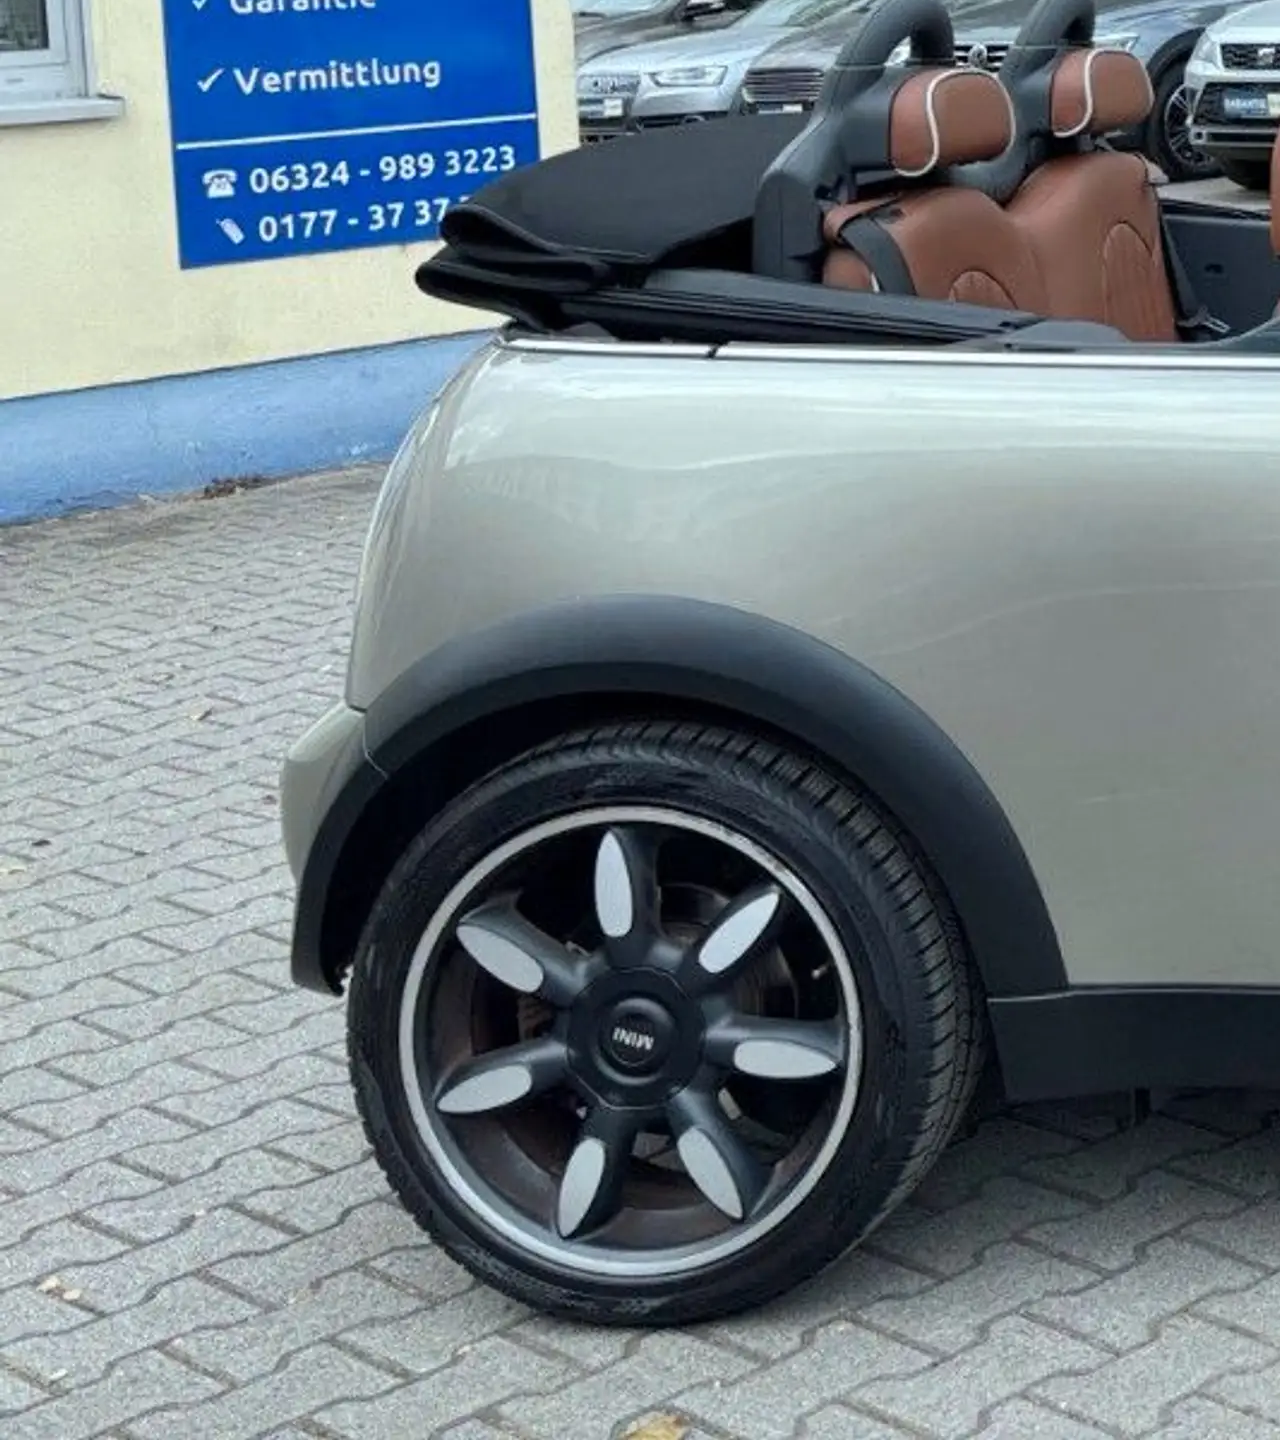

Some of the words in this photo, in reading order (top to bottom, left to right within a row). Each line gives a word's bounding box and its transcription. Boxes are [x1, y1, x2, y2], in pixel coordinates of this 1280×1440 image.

[233, 59, 442, 95] Vermittlung
[249, 160, 350, 195] 06324
[378, 152, 435, 182] 989
[444, 145, 516, 176] 3223
[258, 209, 338, 243] 0177
[367, 201, 405, 232] 37
[414, 197, 452, 227] 37
[612, 1027, 654, 1050] MINI
